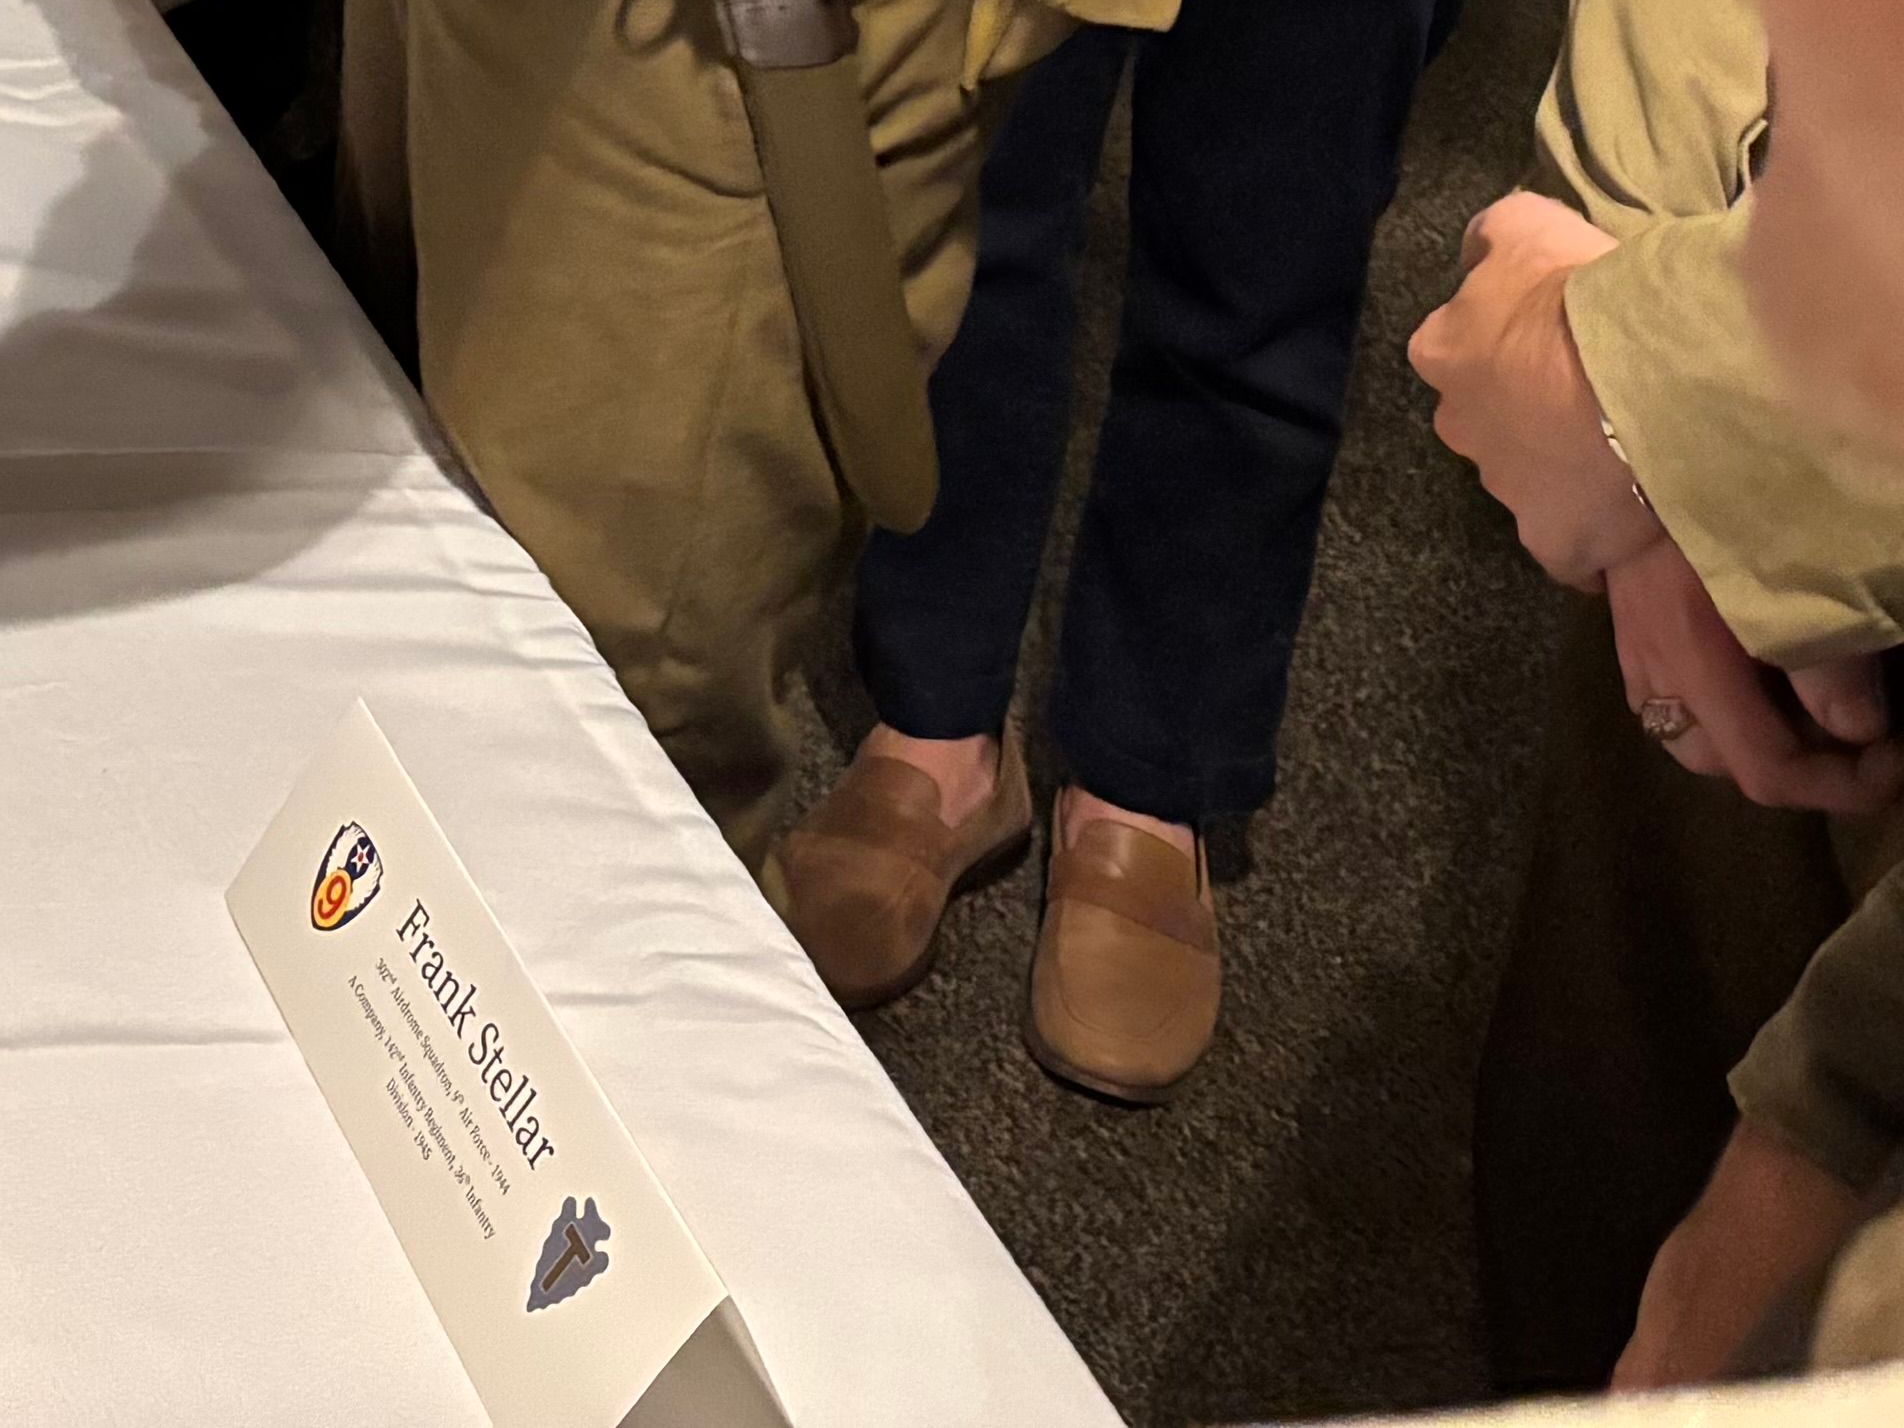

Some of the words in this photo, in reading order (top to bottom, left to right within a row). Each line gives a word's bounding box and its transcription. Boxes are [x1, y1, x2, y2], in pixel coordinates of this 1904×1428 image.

[317, 875, 348, 920] 9
[347, 975, 357, 989] A
[354, 983, 386, 1041] Company,
[398, 1061, 428, 1112] Infantry
[423, 1106, 456, 1171] Regiment,
[465, 1184, 496, 1240] Infantry
[385, 1076, 413, 1128] Division
[413, 1129, 432, 1160] 1945
[389, 986, 423, 1040] Airdrome
[419, 1034, 452, 1096] Squadron,
[458, 1106, 473, 1128] Air
[490, 1163, 510, 1195] 1944
[395, 897, 477, 1040] Frank
[467, 1022, 554, 1171] Stellar
